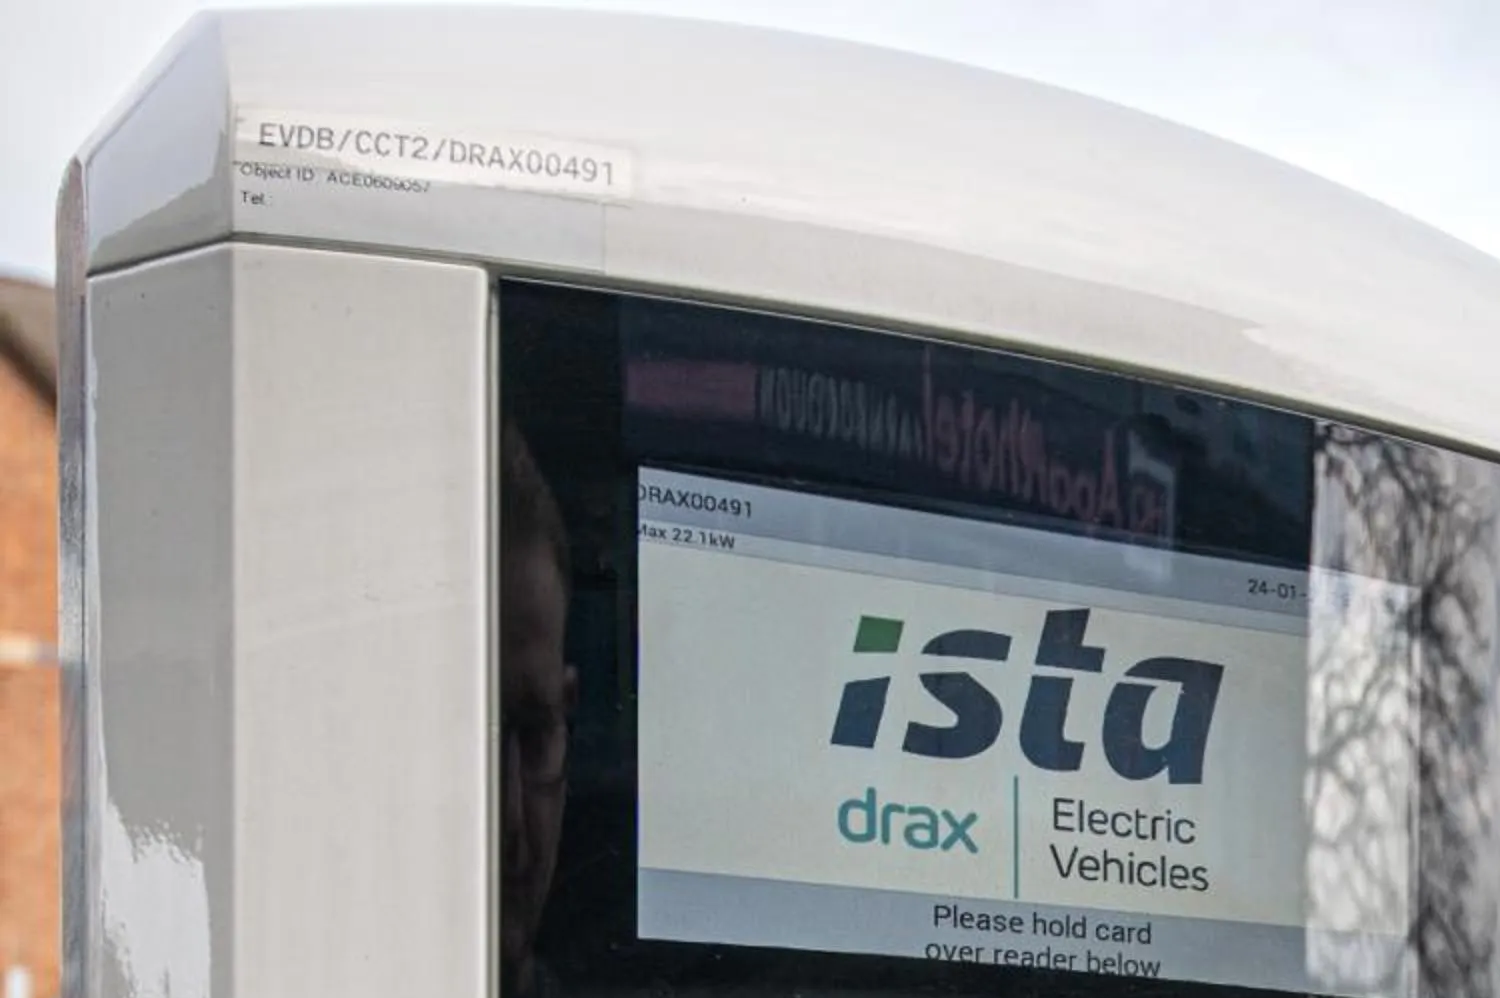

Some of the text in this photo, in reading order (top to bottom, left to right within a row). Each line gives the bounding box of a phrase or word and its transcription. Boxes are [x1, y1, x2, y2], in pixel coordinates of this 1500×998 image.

[240, 161, 291, 181] Object
[259, 122, 615, 186] EVDB/CCT2/DRAX00491
[830, 607, 1225, 786] ista
[837, 787, 979, 854] drax
[1052, 797, 1197, 844] Electric
[1049, 844, 1211, 893] Vehicles
[933, 904, 1153, 945] Please hold card
[925, 943, 1161, 977] over reader below
